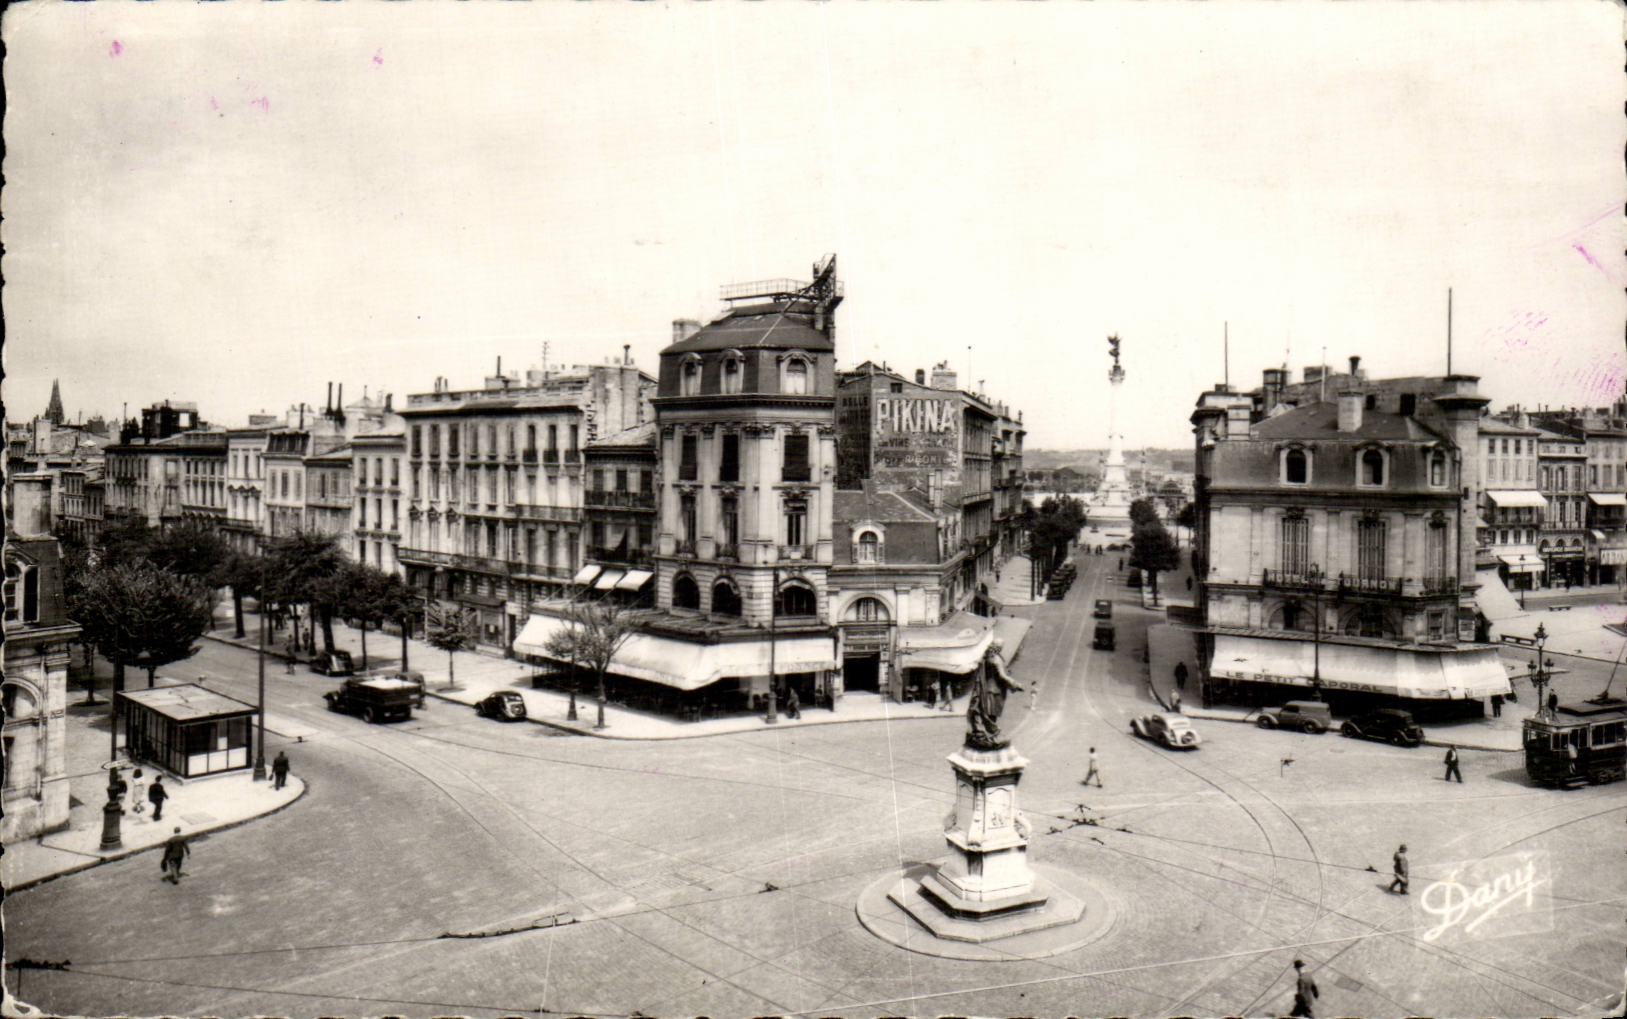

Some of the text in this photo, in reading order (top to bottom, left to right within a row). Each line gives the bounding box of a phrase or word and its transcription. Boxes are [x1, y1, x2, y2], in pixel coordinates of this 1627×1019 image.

[876, 399, 956, 434] PIKINA
[1226, 671, 1382, 693] LE PETIT CAPORAL
